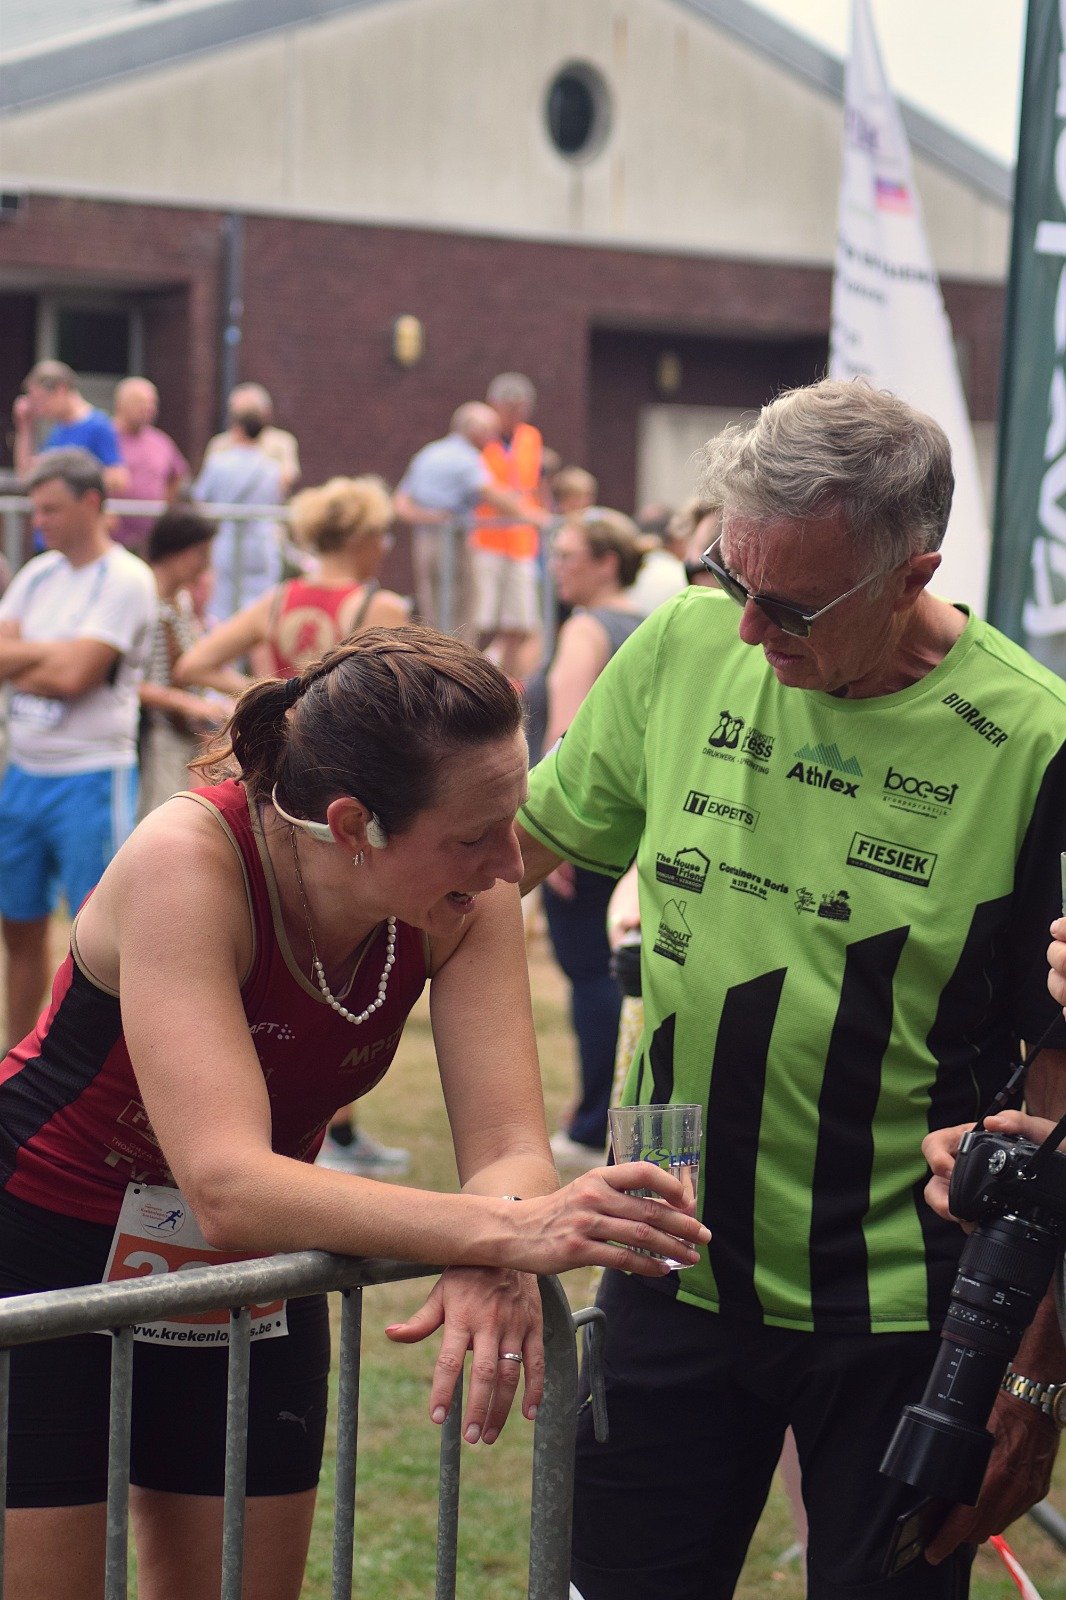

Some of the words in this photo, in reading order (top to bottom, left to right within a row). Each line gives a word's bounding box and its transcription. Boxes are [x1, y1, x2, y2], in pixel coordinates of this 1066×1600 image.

[941, 692, 1008, 748] BIORACER
[785, 761, 860, 798] Athlex
[684, 791, 708, 814] IT
[656, 851, 672, 864] The
[673, 857, 701, 873] House
[857, 839, 930, 875] FIESIEK
[678, 867, 706, 881] Friend
[763, 878, 790, 895] Boris
